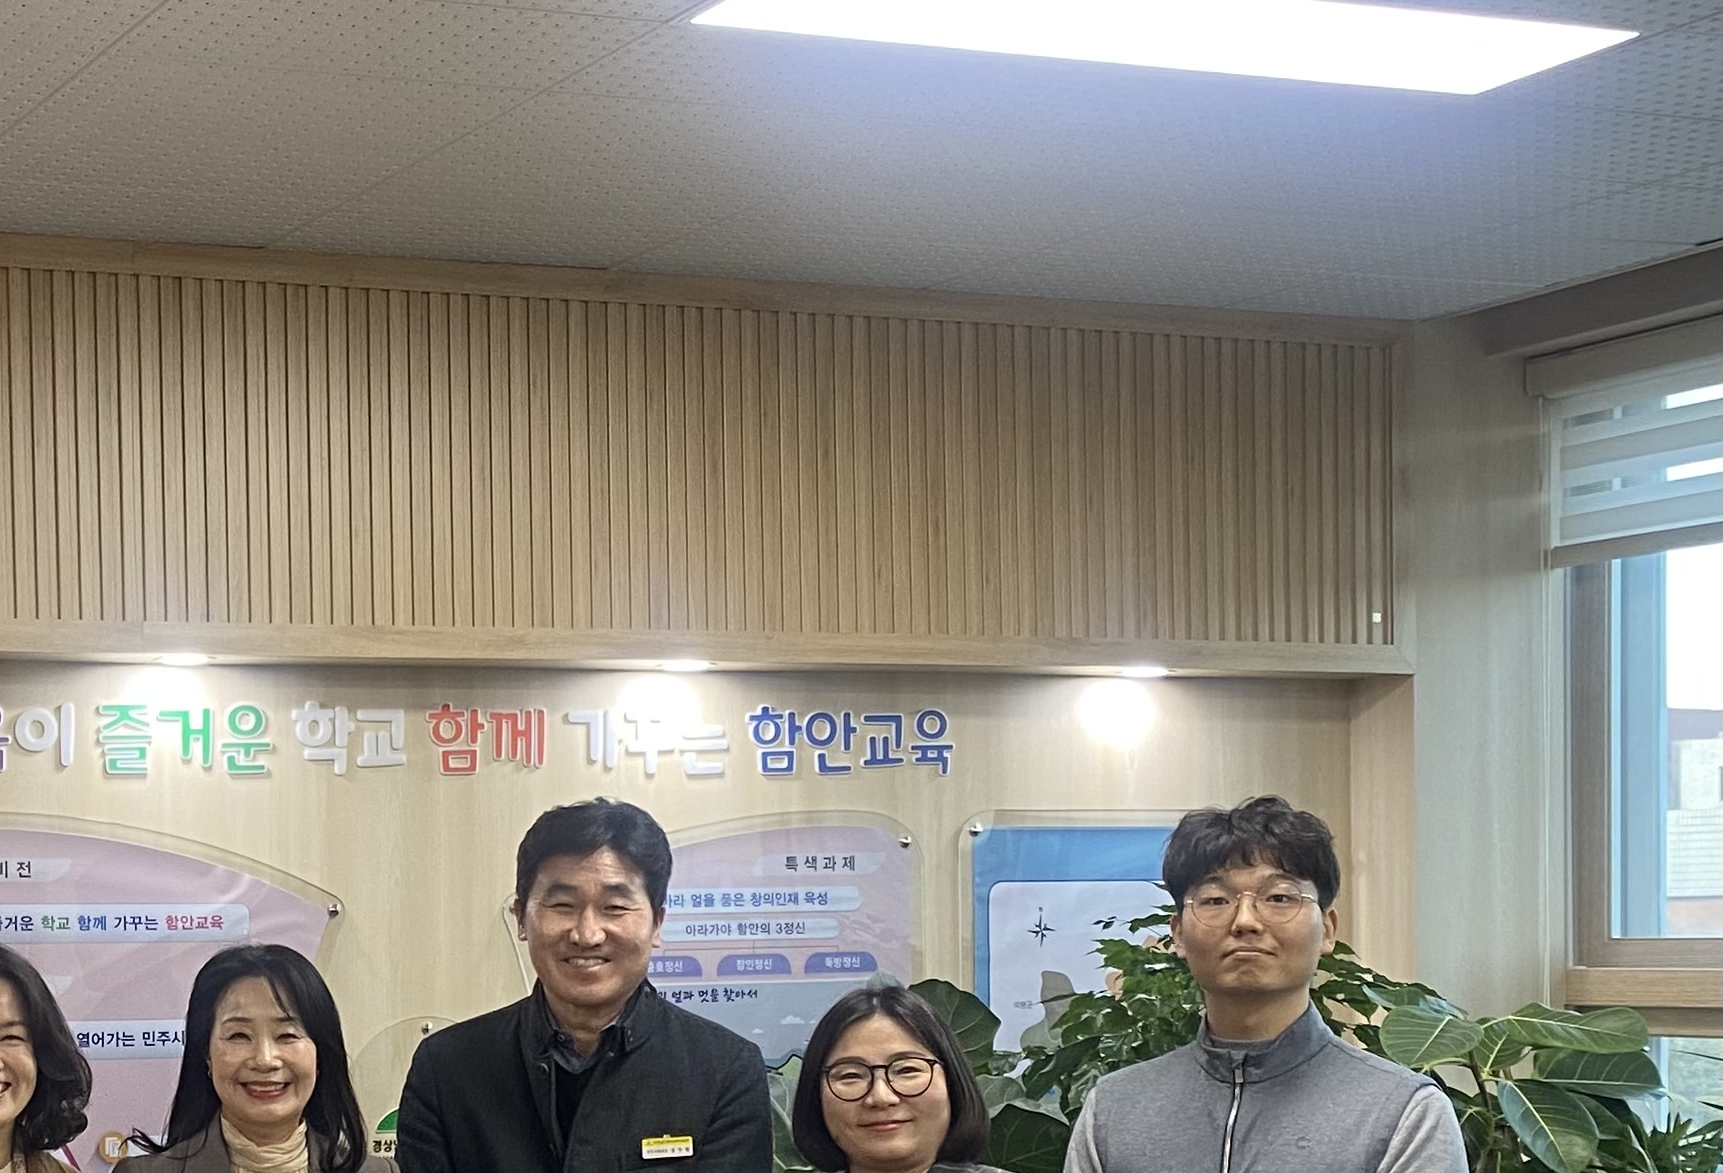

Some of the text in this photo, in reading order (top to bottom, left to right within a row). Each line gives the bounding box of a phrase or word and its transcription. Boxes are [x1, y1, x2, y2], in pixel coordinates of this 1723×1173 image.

[97, 701, 273, 776] 즐거운
[291, 700, 407, 776] 학교
[426, 703, 548, 776] 함께
[566, 708, 729, 776] 가꾸는
[745, 704, 955, 777] 함안교육
[690, 892, 715, 908] 얼을
[750, 891, 800, 907] 창의인재
[803, 891, 829, 907] 육성
[40, 914, 72, 932] 학교
[77, 914, 108, 932] 함께
[113, 914, 159, 932] 가꾸는
[164, 914, 224, 931] 함안교육
[685, 920, 807, 938] 아라가야 함안의 3정신
[722, 987, 759, 1003] 찾아서
[76, 1031, 136, 1048] 열어가는
[372, 1139, 398, 1154] 경상
